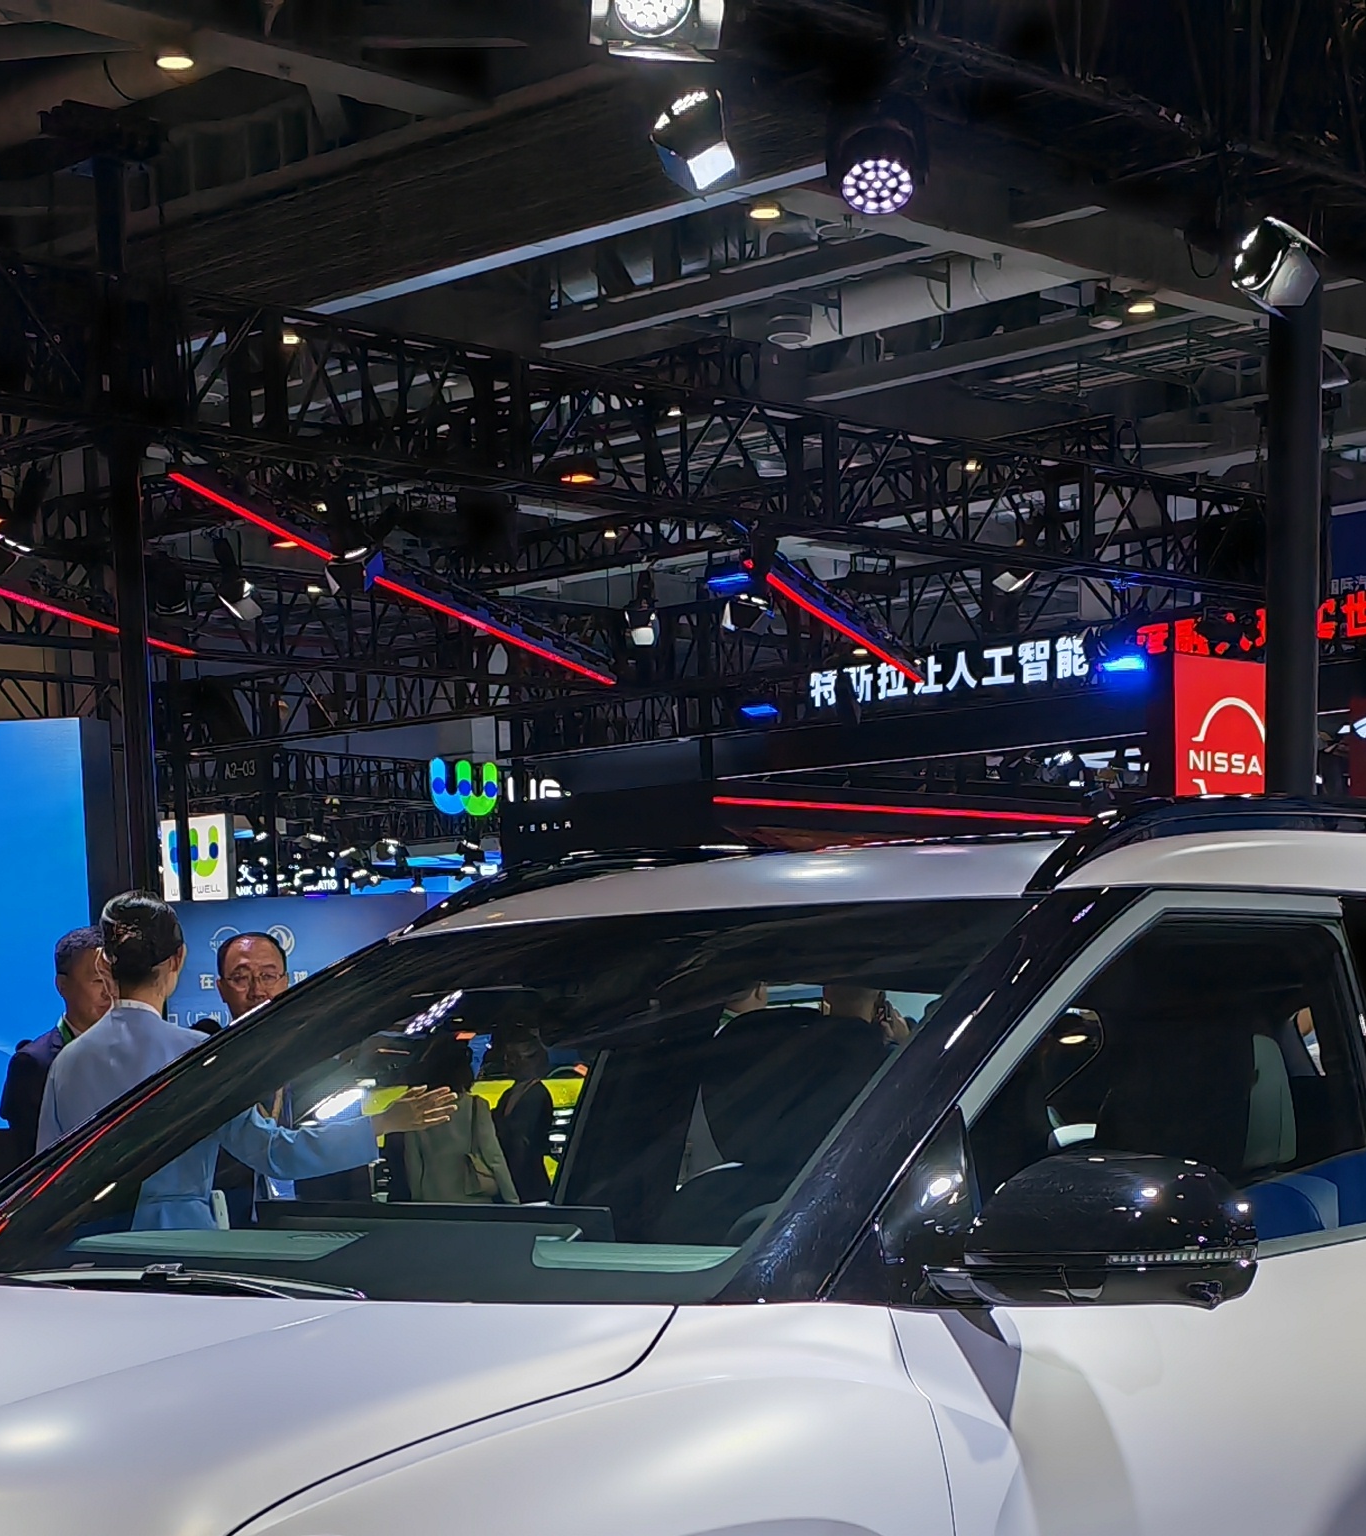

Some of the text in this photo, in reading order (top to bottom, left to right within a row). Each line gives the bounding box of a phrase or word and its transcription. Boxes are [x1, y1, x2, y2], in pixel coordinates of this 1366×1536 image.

[225, 760, 255, 779] A2-03
[1189, 750, 1263, 775] NISSA
[519, 821, 572, 833] TESLA
[171, 884, 221, 896] WWELL
